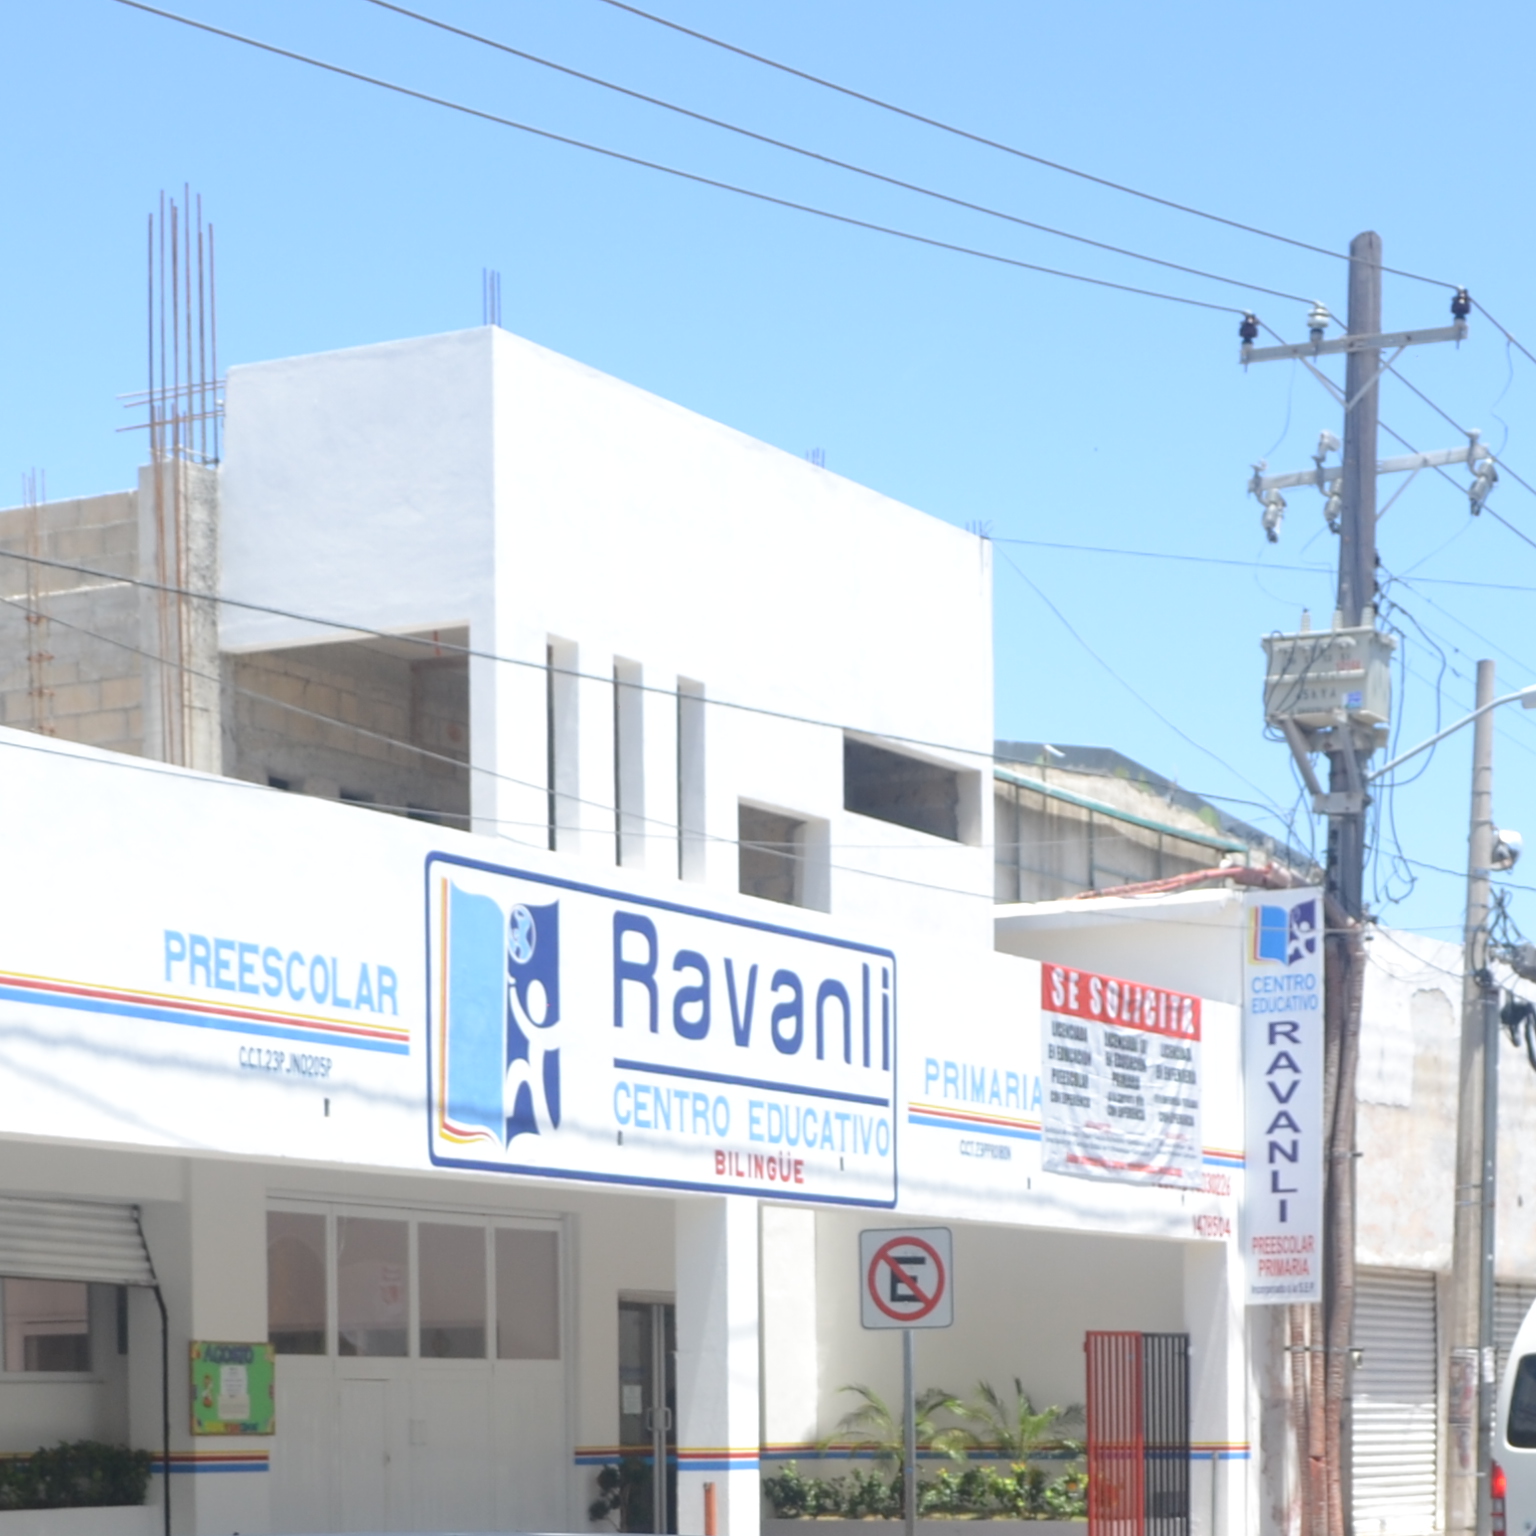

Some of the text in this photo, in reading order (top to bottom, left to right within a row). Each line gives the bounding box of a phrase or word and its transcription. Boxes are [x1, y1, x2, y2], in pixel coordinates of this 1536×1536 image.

[164, 929, 400, 1016] PREESCOLAR
[613, 910, 891, 1072] Ravanli
[1051, 967, 1195, 1034] SE SOLICITA
[1251, 973, 1317, 994] CENTRO
[1251, 994, 1319, 1015] EDUCATIVO
[925, 1056, 1042, 1112] PRIMARIA
[613, 1081, 891, 1158] CENTRO EDUCATIVO
[1266, 1020, 1303, 1223] RAVANLI
[714, 1149, 805, 1184] BILINGÜE
[1251, 1235, 1315, 1255] PREESCOLAR
[1258, 1258, 1310, 1277] PRIMARIA
